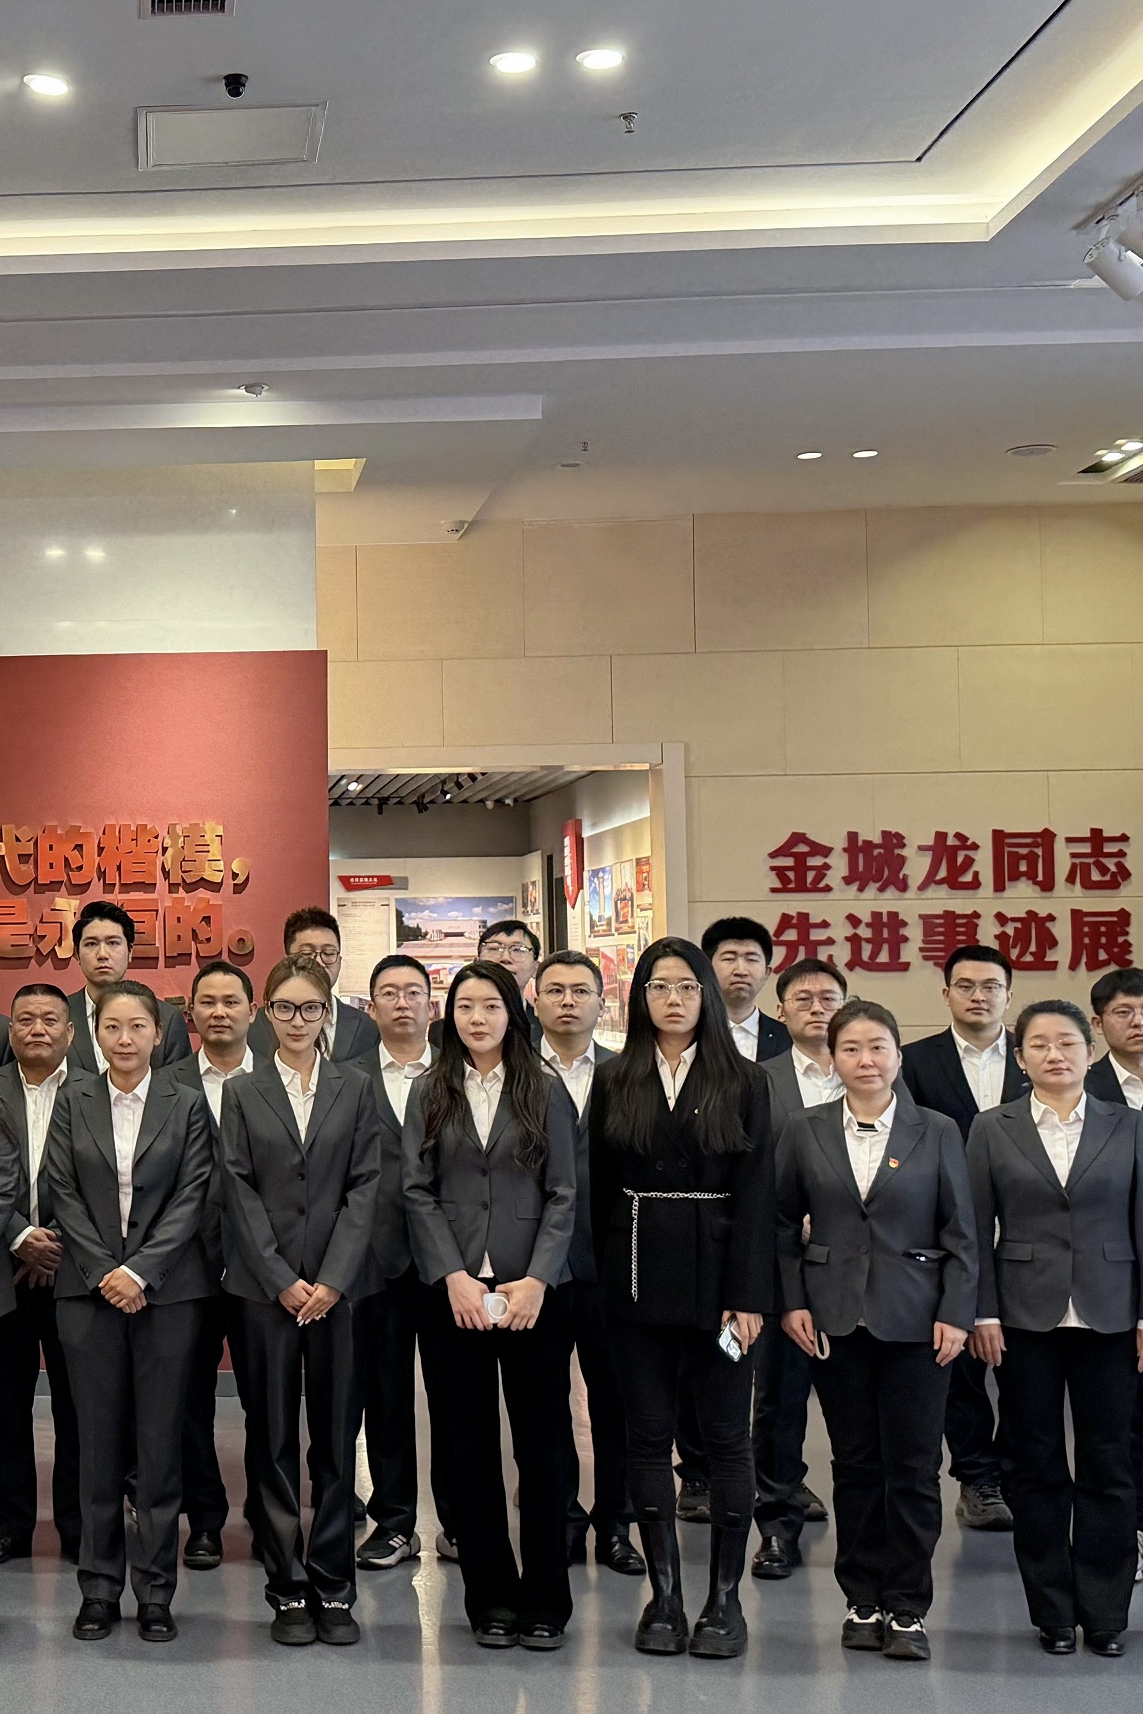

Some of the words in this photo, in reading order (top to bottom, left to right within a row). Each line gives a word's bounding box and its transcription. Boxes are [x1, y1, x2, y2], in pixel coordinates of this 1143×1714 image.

[768, 827, 1132, 893] 金城龙同志
[771, 907, 1134, 975] 先进事迹展
